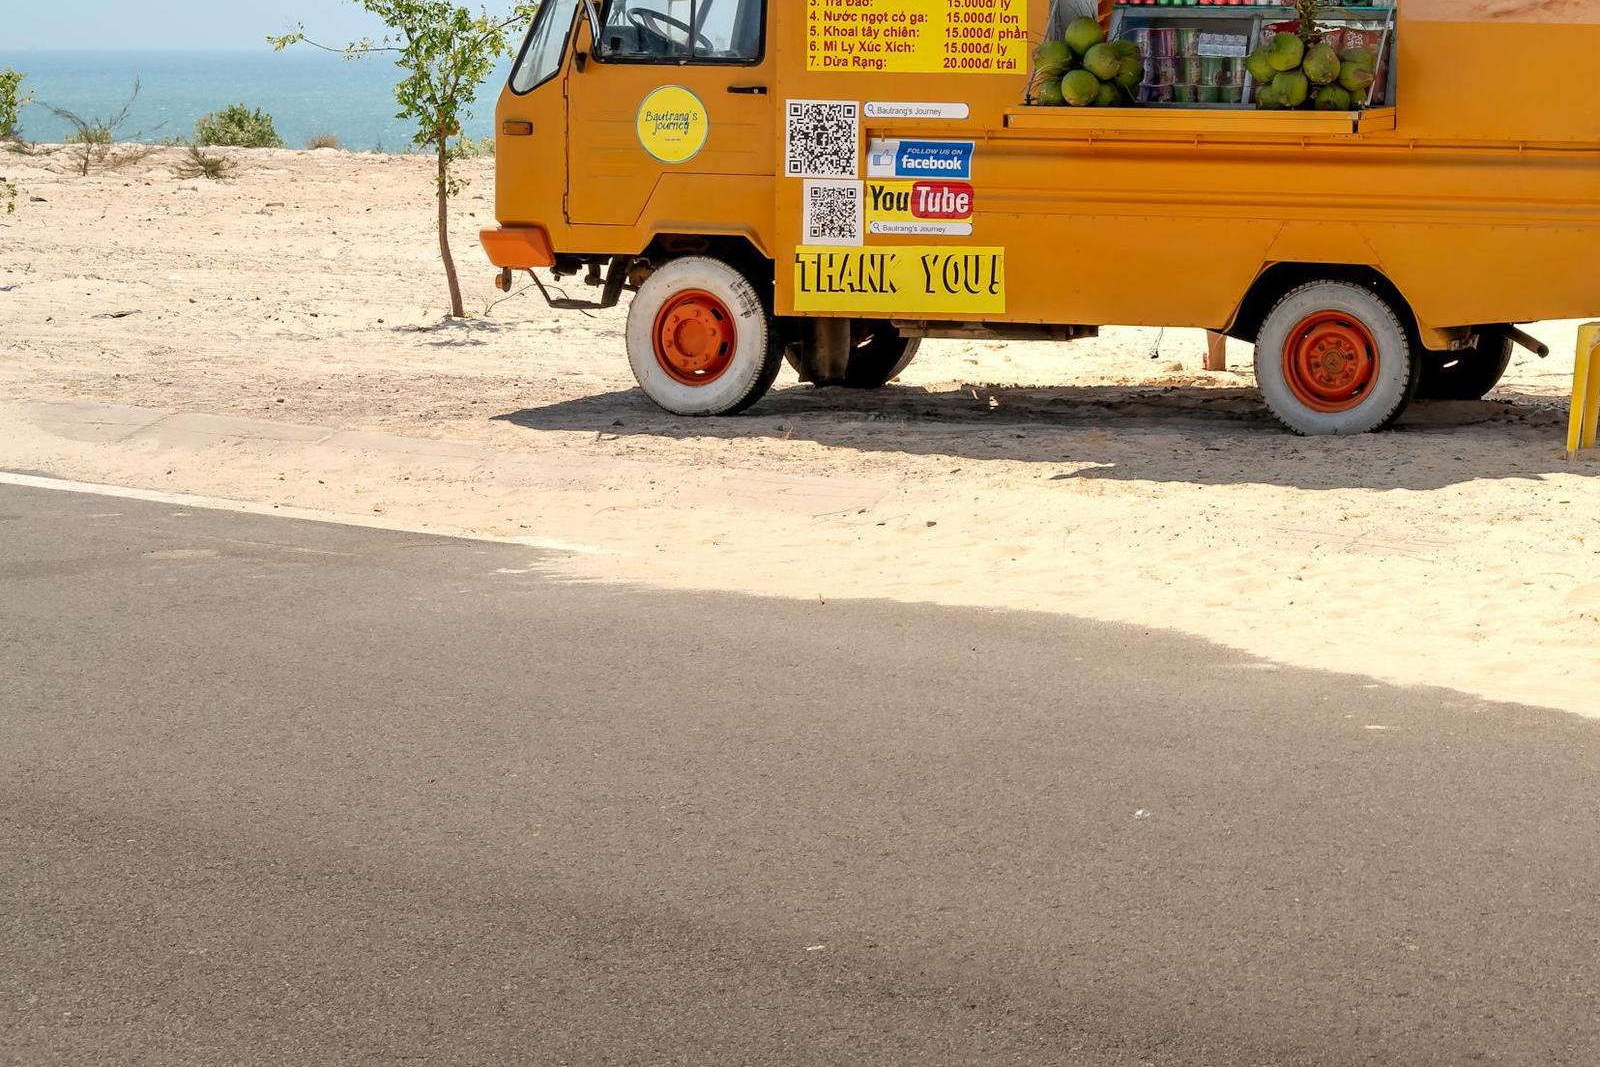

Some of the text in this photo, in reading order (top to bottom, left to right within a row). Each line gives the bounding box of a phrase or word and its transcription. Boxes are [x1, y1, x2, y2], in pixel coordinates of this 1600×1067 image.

[809, 10, 820, 21] 4.
[823, 10, 858, 22] Nước
[861, 12, 888, 24] ngọt
[892, 11, 906, 22] có
[910, 14, 928, 24] ga:
[1000, 12, 1019, 24] lon
[810, 25, 820, 37] 5.
[823, 25, 858, 37] Khoai
[861, 26, 880, 39] tây
[883, 26, 920, 38] chiên:
[998, 26, 1028, 41] phần
[809, 40, 820, 51] 6.
[841, 41, 855, 54] Ly
[859, 40, 881, 52] Xúc
[885, 40, 915, 52] Xích:
[997, 43, 1008, 56] ly
[809, 55, 820, 66] 7.
[852, 55, 887, 69] Rạng:
[996, 58, 1016, 69] trái
[645, 110, 698, 123] Bautrang's
[877, 106, 942, 116] Bautrang's Journey
[906, 147, 938, 155] FOLLOW
[940, 147, 950, 155] US
[902, 154, 962, 170] facebook
[882, 224, 946, 233] Bautrang's Journey
[795, 253, 1003, 295] THANK YOU!
